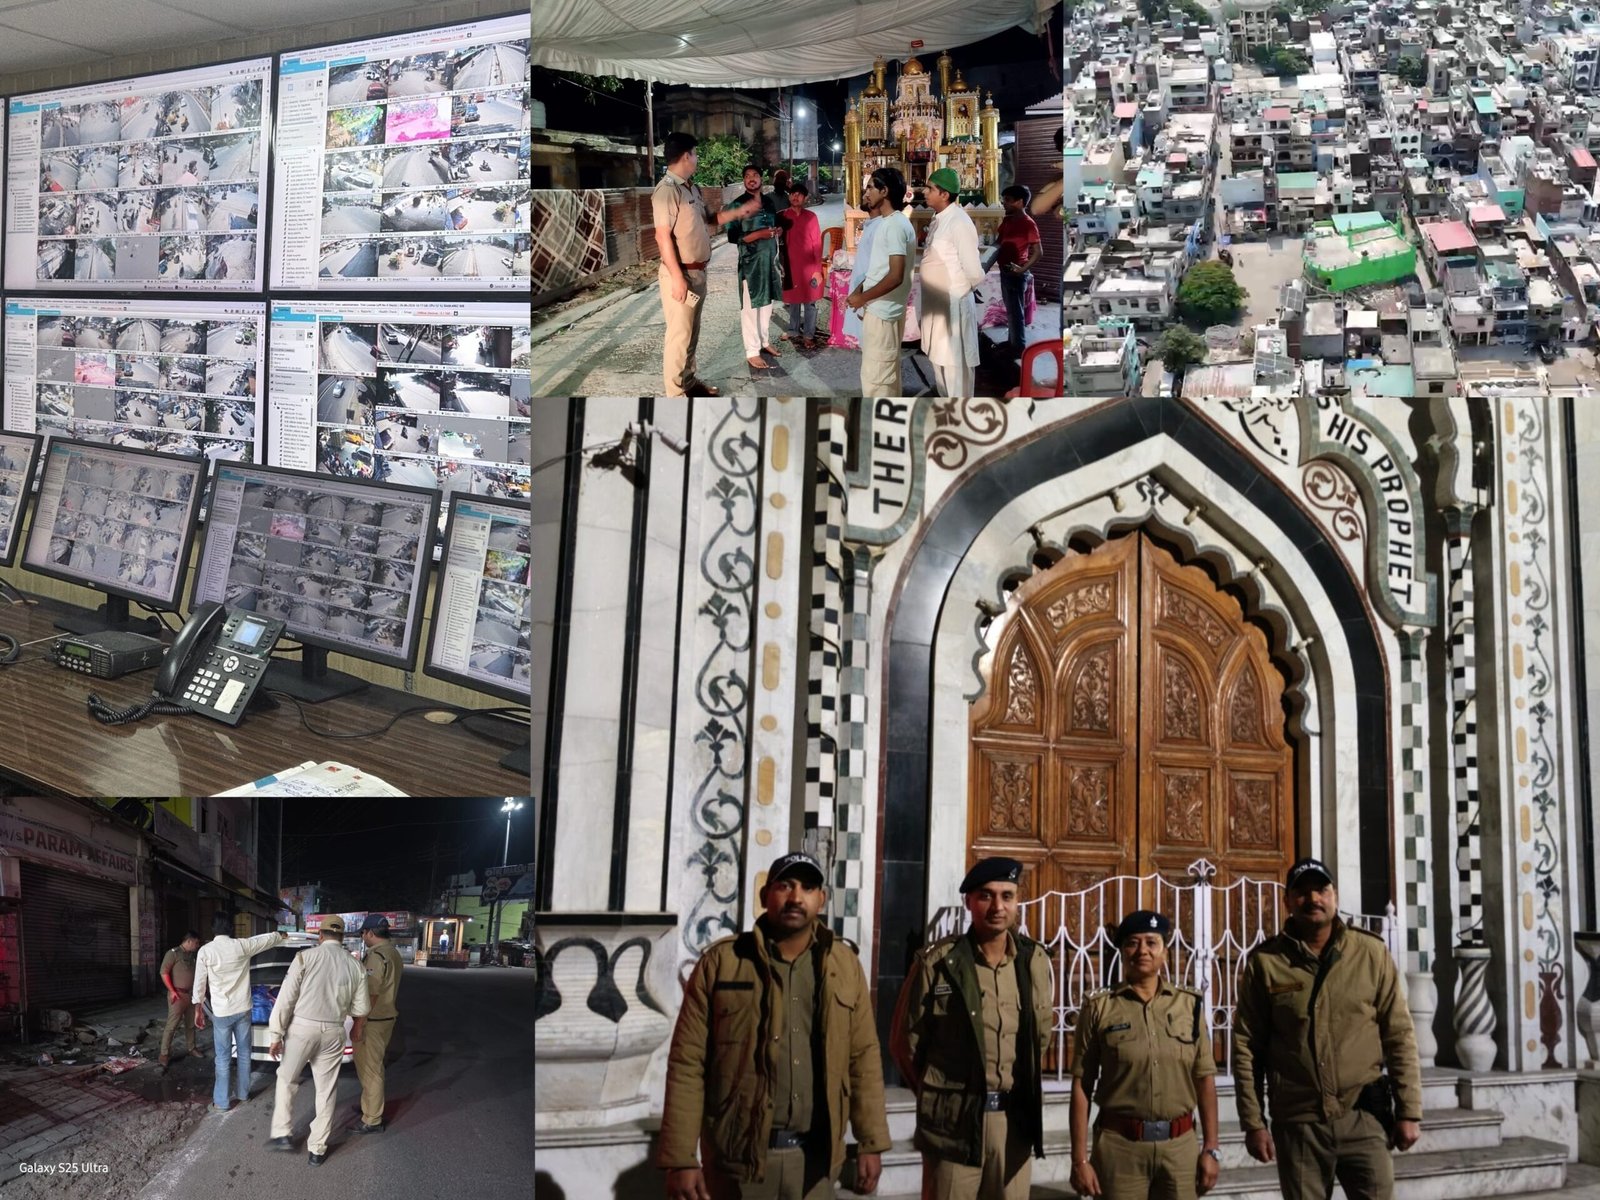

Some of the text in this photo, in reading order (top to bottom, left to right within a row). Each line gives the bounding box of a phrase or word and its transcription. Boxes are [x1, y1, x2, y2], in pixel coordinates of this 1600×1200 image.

[873, 398, 908, 514] THER
[1327, 413, 1372, 455] HIS
[1371, 454, 1413, 605] PROPHET
[23, 827, 82, 858] PARAM
